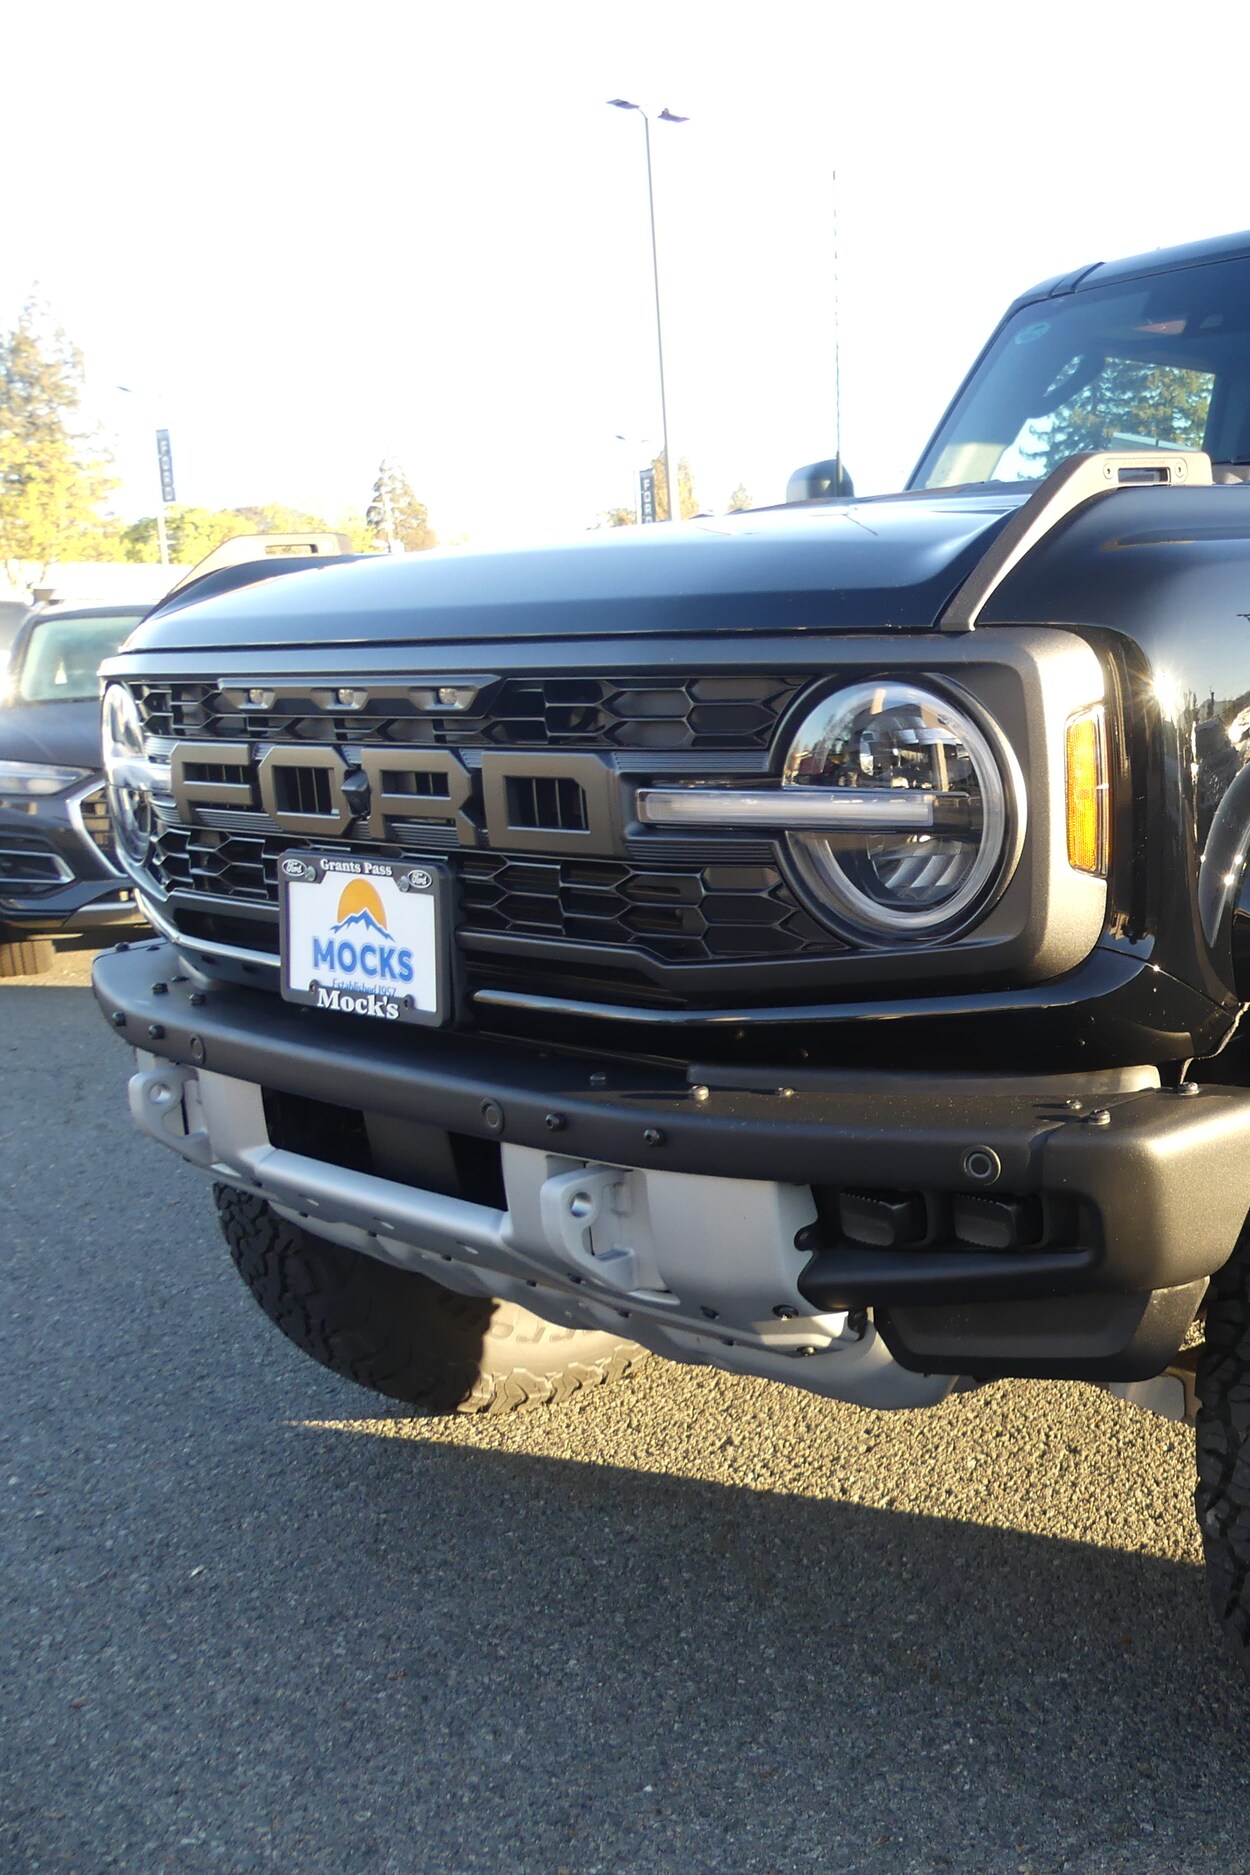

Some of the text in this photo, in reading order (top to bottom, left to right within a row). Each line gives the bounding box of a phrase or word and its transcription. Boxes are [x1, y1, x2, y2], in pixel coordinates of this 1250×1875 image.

[170, 741, 616, 857] FORD
[284, 860, 304, 874] Ford
[320, 858, 393, 876] Grants Pass
[410, 871, 429, 886] Ford
[312, 937, 414, 982] MOCKS
[333, 978, 397, 998] Established 1957
[317, 987, 400, 1020] Mock's
